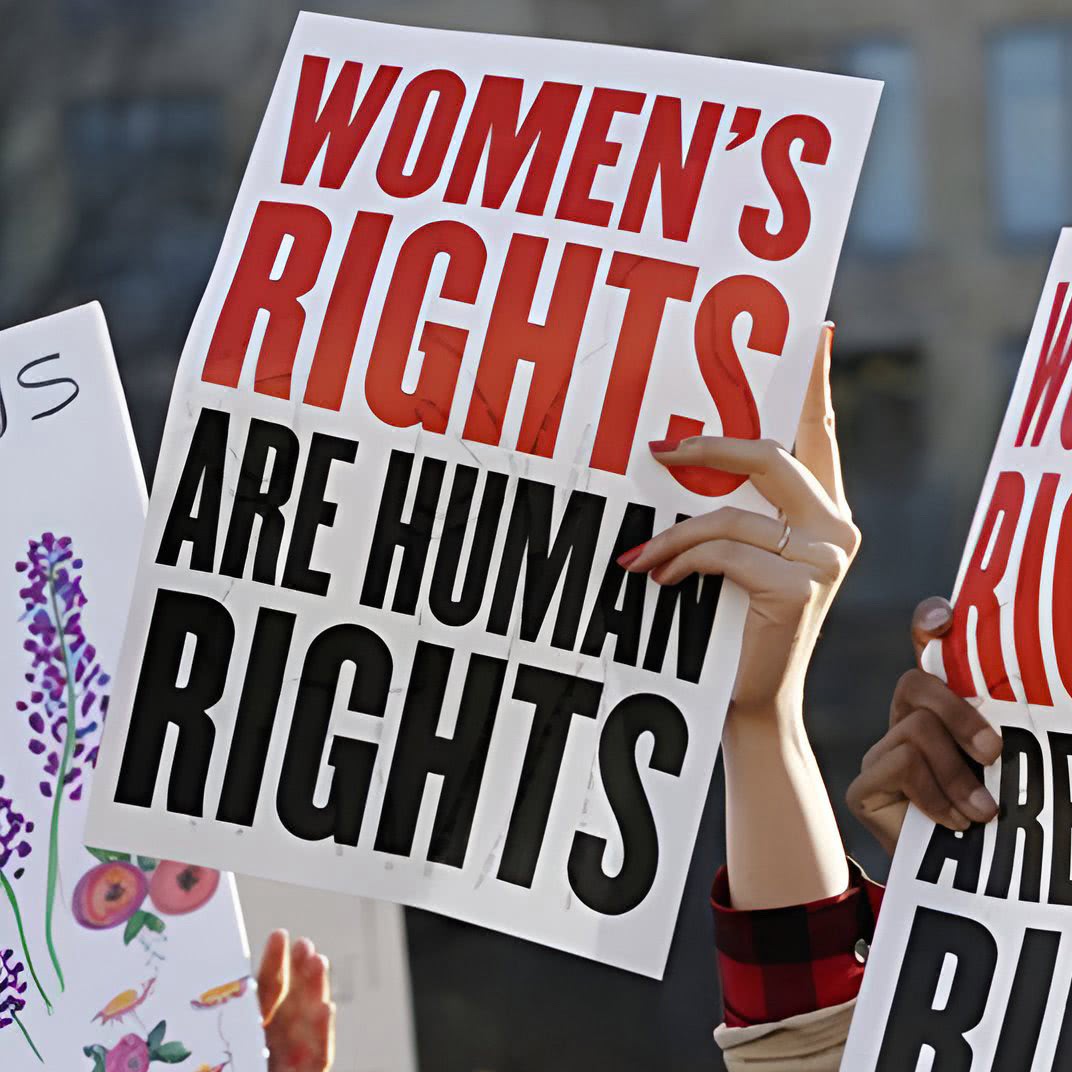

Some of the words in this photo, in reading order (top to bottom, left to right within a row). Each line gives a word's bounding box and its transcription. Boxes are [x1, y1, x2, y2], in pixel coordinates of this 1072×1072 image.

[282, 55, 831, 261] WOMEN'S
[201, 201, 790, 497] RIGHTS
[155, 408, 359, 596] ARE
[360, 450, 725, 684] HUMAN
[114, 588, 688, 915] RIGHTS
